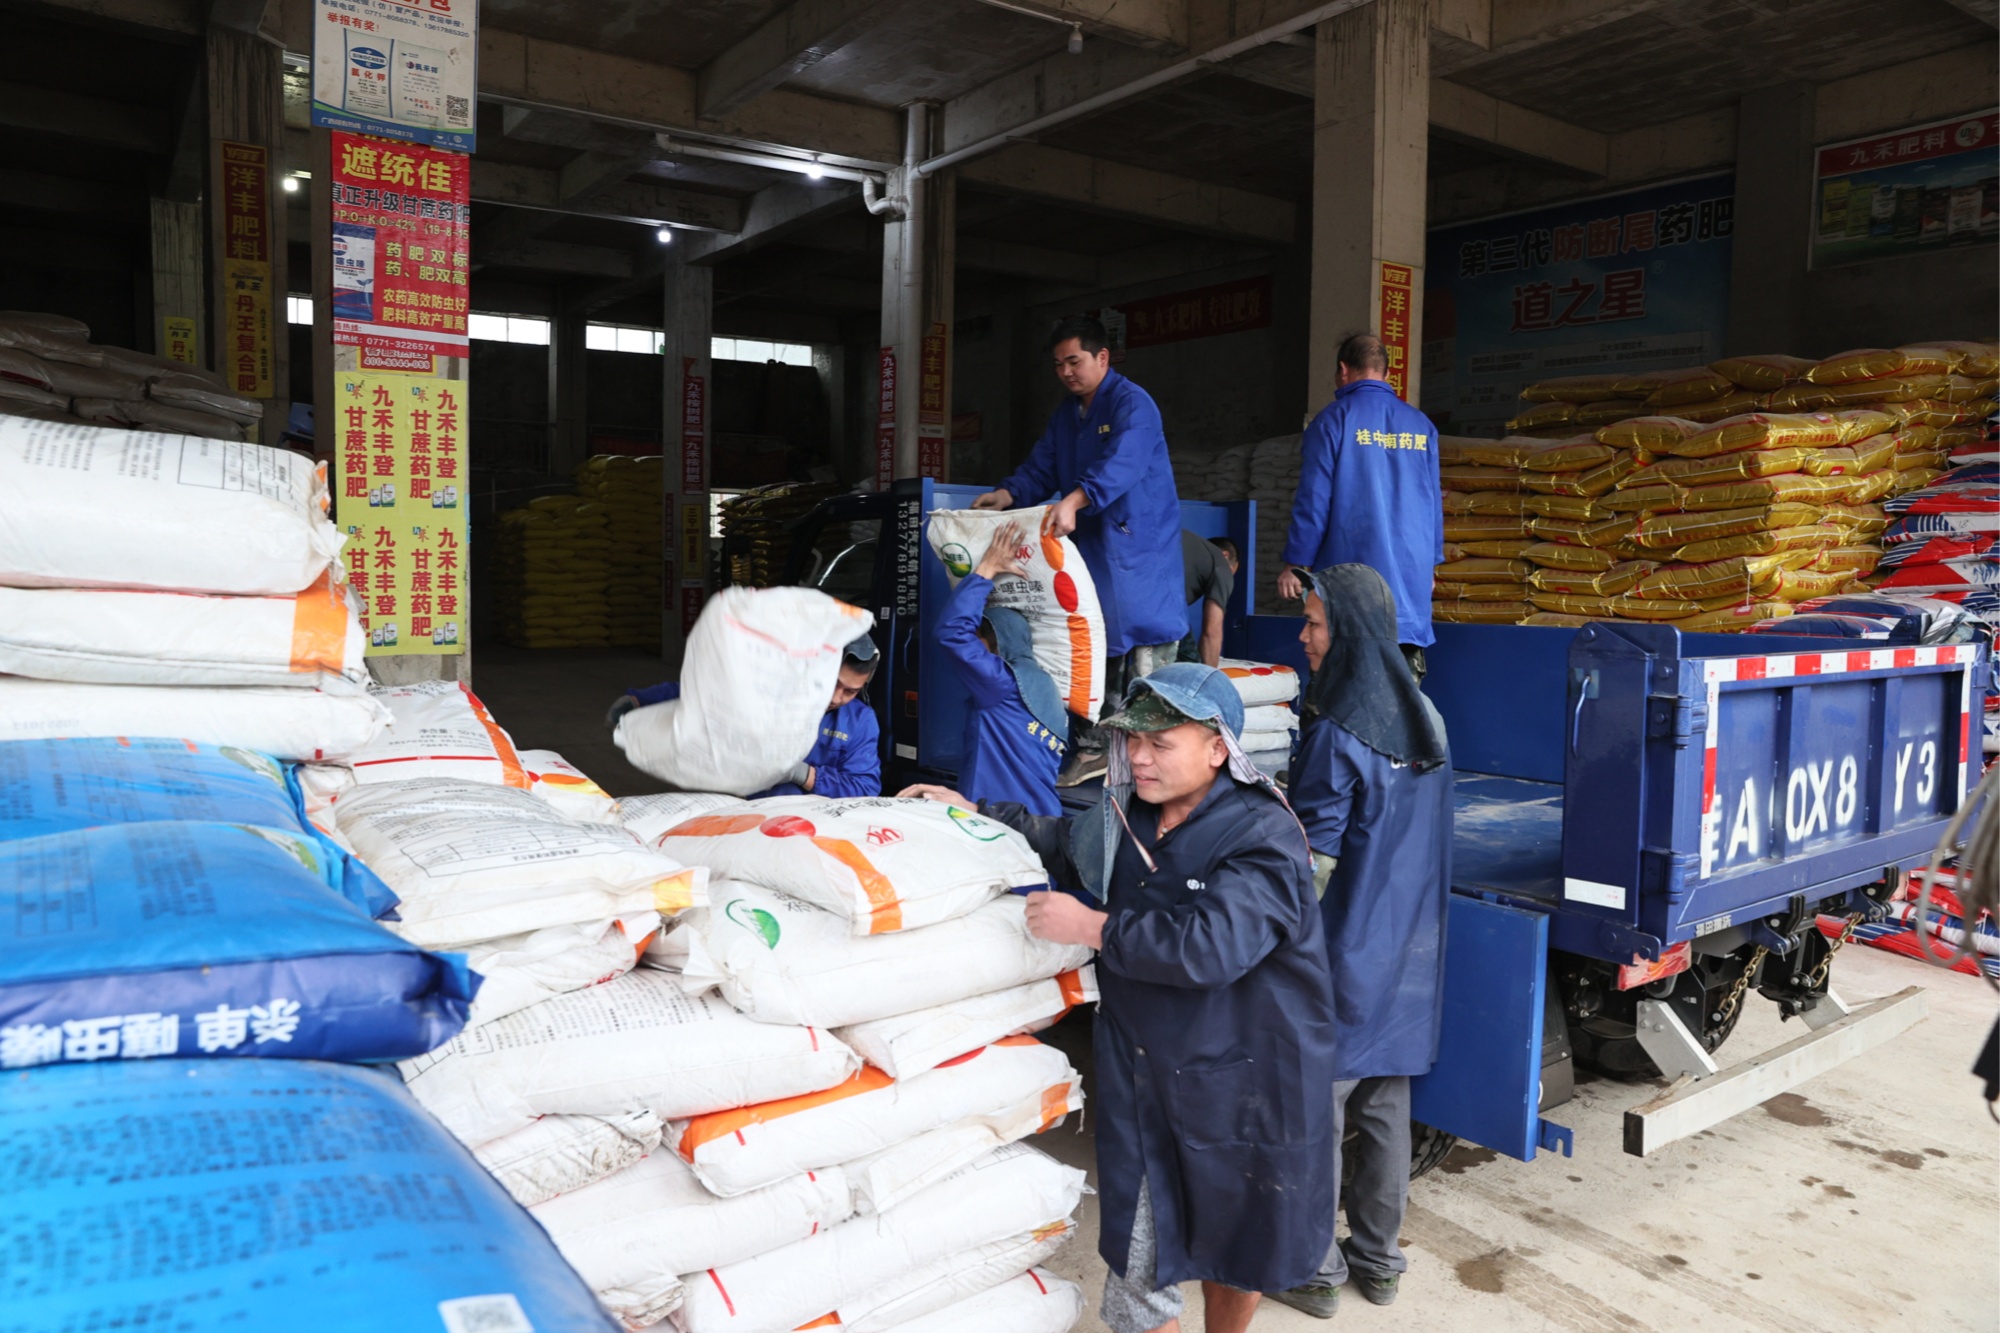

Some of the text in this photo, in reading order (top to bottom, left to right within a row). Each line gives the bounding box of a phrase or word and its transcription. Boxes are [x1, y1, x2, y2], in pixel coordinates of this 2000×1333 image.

[351, 67, 387, 82] 氯化钾
[341, 143, 453, 193] 遮统佳
[1848, 130, 1947, 167] 九禾肥料
[230, 166, 260, 261] 洋丰肥料
[1458, 195, 1734, 280] 第三代防断尾药肥
[382, 288, 467, 312] 农药高效防虫好
[385, 261, 467, 286] 药、肥双高
[1510, 267, 1647, 334] 道之星
[236, 294, 258, 392] 丹王复合肥
[382, 307, 466, 331] 肥料高效产量高
[881, 356, 895, 413] 九禾桉树肥
[922, 338, 943, 408] 洋丰肥料
[344, 405, 369, 498] 甘蔗药肥
[372, 384, 395, 477] 九禾丰登
[409, 409, 432, 500] 甘蔗药肥
[436, 389, 458, 479] 九禾丰登
[1355, 428, 1429, 452] 桂中南药肥
[374, 525, 397, 616] 九禾丰登
[410, 548, 433, 637] 甘蔗药肥
[436, 527, 459, 616] 九禾丰登
[896, 500, 908, 616] 13277891880
[194, 998, 301, 1054] 杀单
